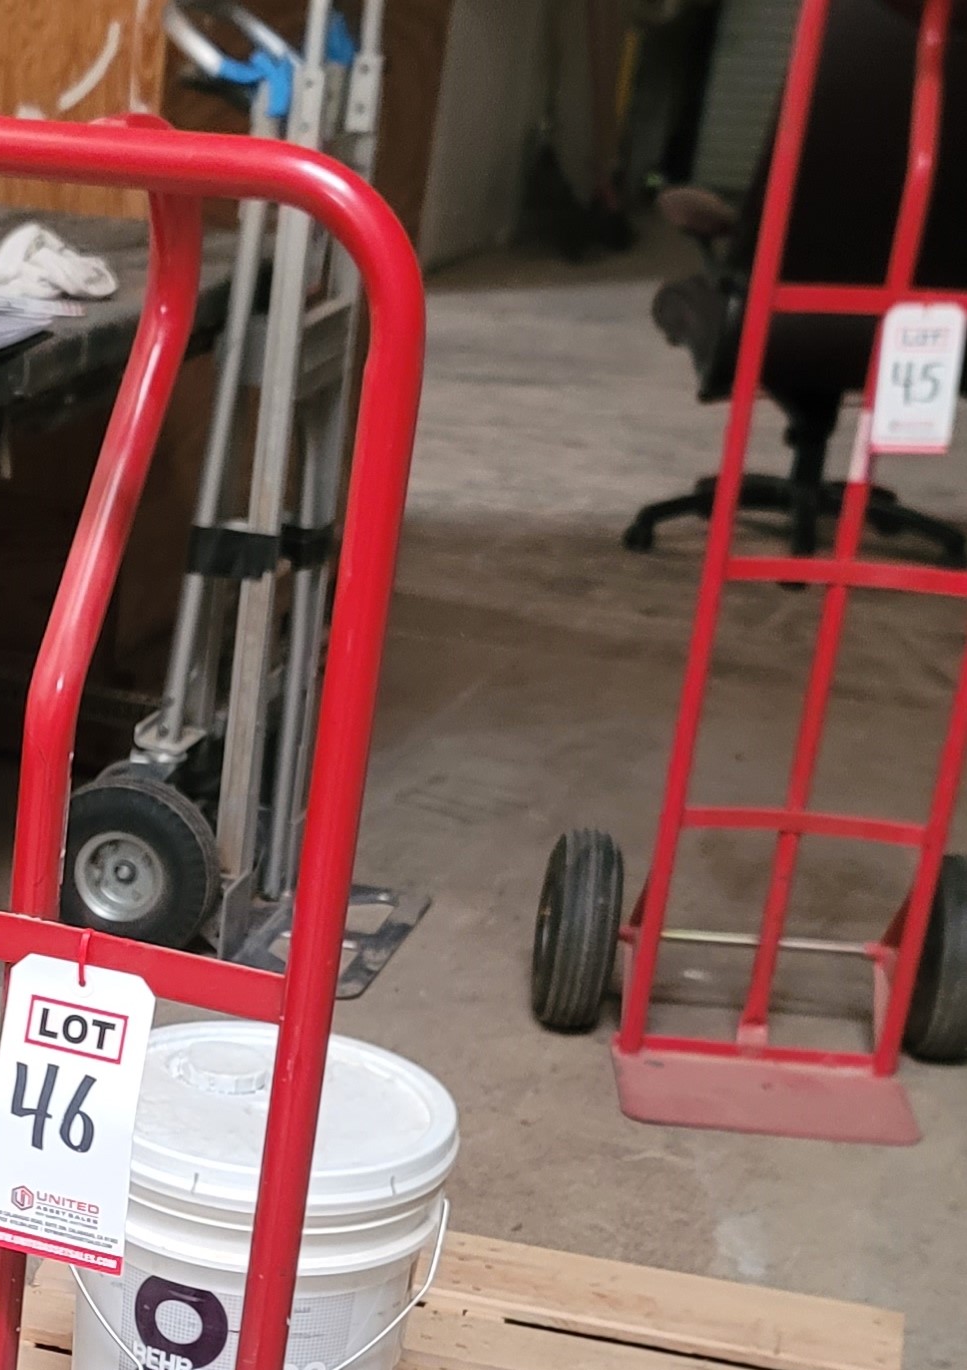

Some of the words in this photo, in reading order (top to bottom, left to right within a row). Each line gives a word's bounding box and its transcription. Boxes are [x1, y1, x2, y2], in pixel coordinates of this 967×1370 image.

[891, 361, 944, 407] 45
[39, 1007, 116, 1050] LOT
[11, 1062, 97, 1153] 46
[36, 1191, 99, 1214] UNITED
[68, 1212, 98, 1224] SALES
